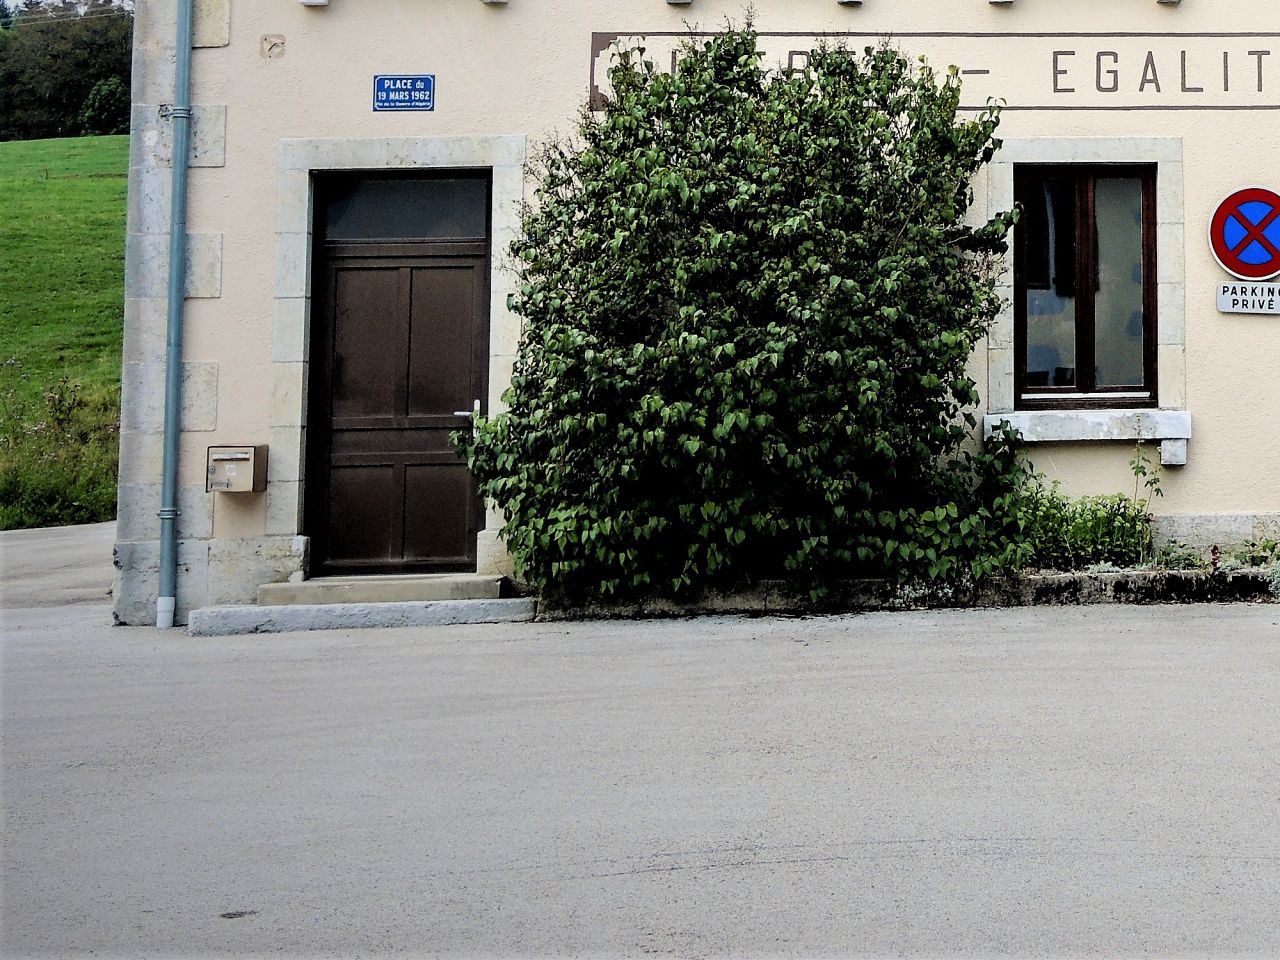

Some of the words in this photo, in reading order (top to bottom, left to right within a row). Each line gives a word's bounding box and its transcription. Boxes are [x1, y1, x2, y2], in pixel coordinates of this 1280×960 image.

[384, 80, 412, 89] PLACE
[415, 80, 424, 89] du
[378, 91, 387, 100] 19
[389, 91, 409, 100] MARS
[411, 91, 430, 100] 1962
[1232, 297, 1275, 310] PRIVÉ
